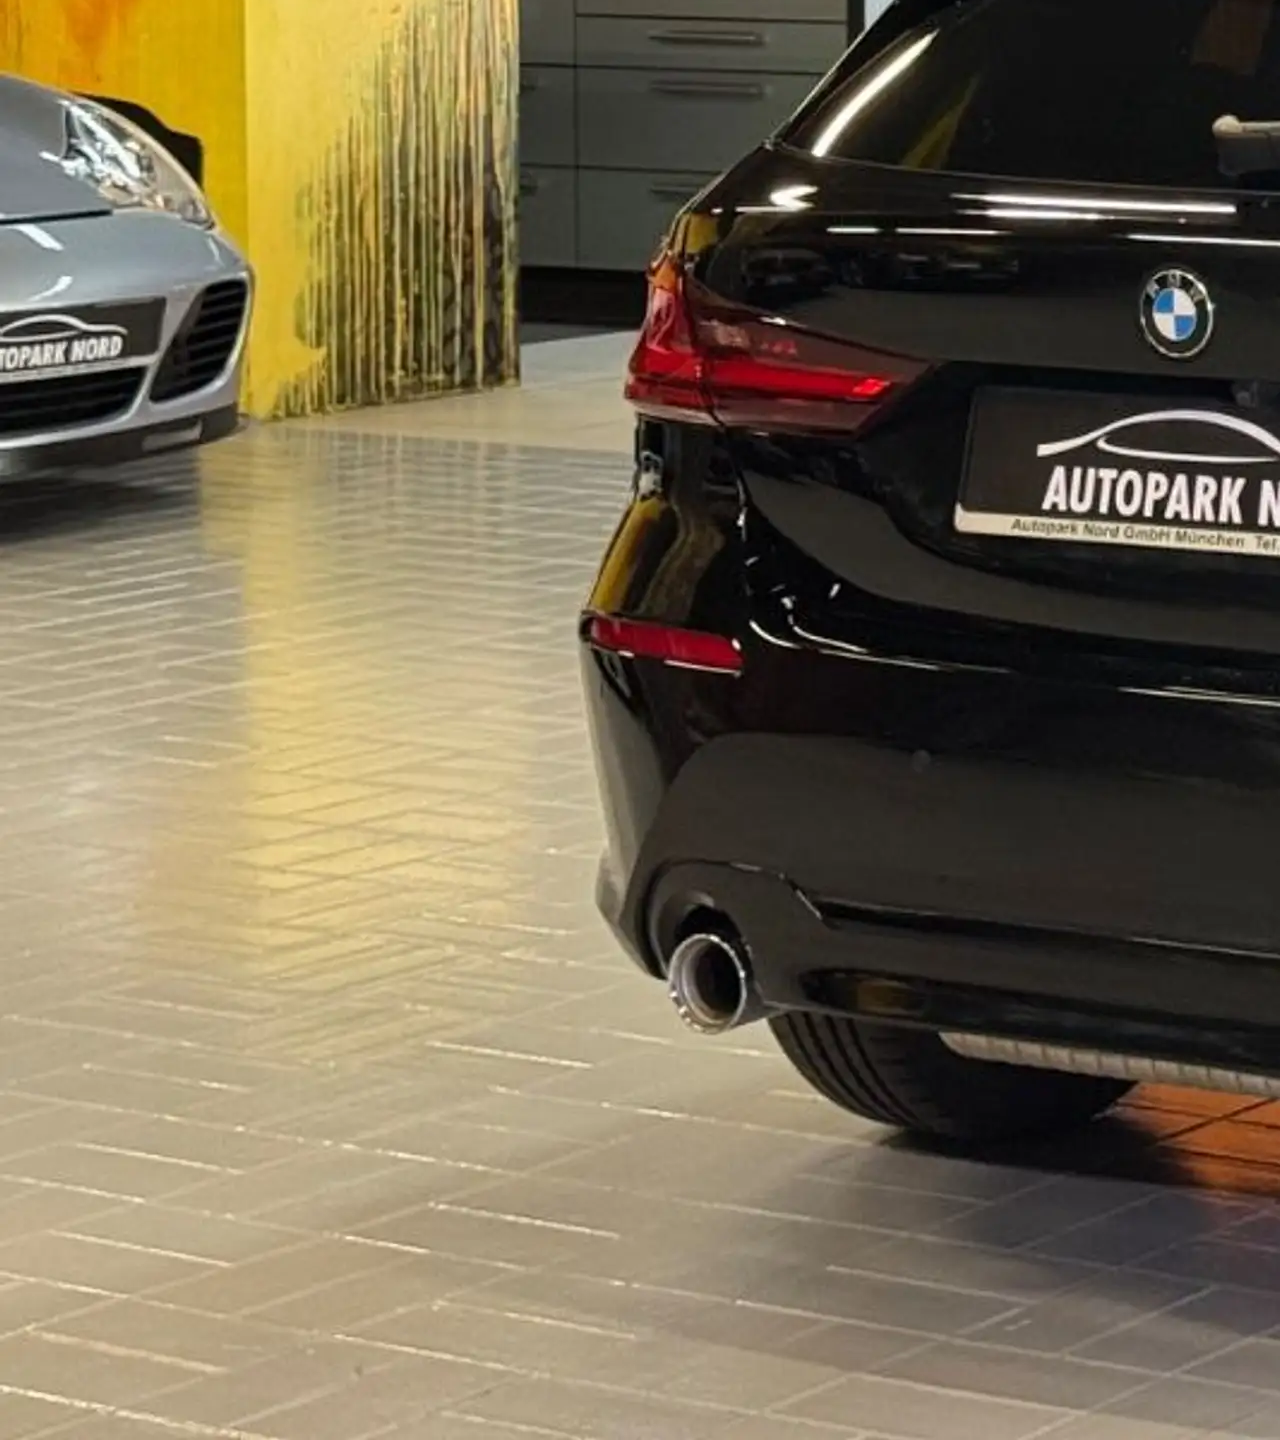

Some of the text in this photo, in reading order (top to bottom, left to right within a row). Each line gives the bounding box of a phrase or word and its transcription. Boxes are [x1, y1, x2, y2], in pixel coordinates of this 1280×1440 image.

[71, 336, 123, 362] NORD
[1041, 465, 1245, 523] AUTOPARK
[1010, 518, 1078, 537] Autopark
[1081, 520, 1120, 539] Nord
[1123, 525, 1172, 544] GmbH
[1174, 529, 1245, 549] München
[1254, 535, 1280, 551] Tel.
